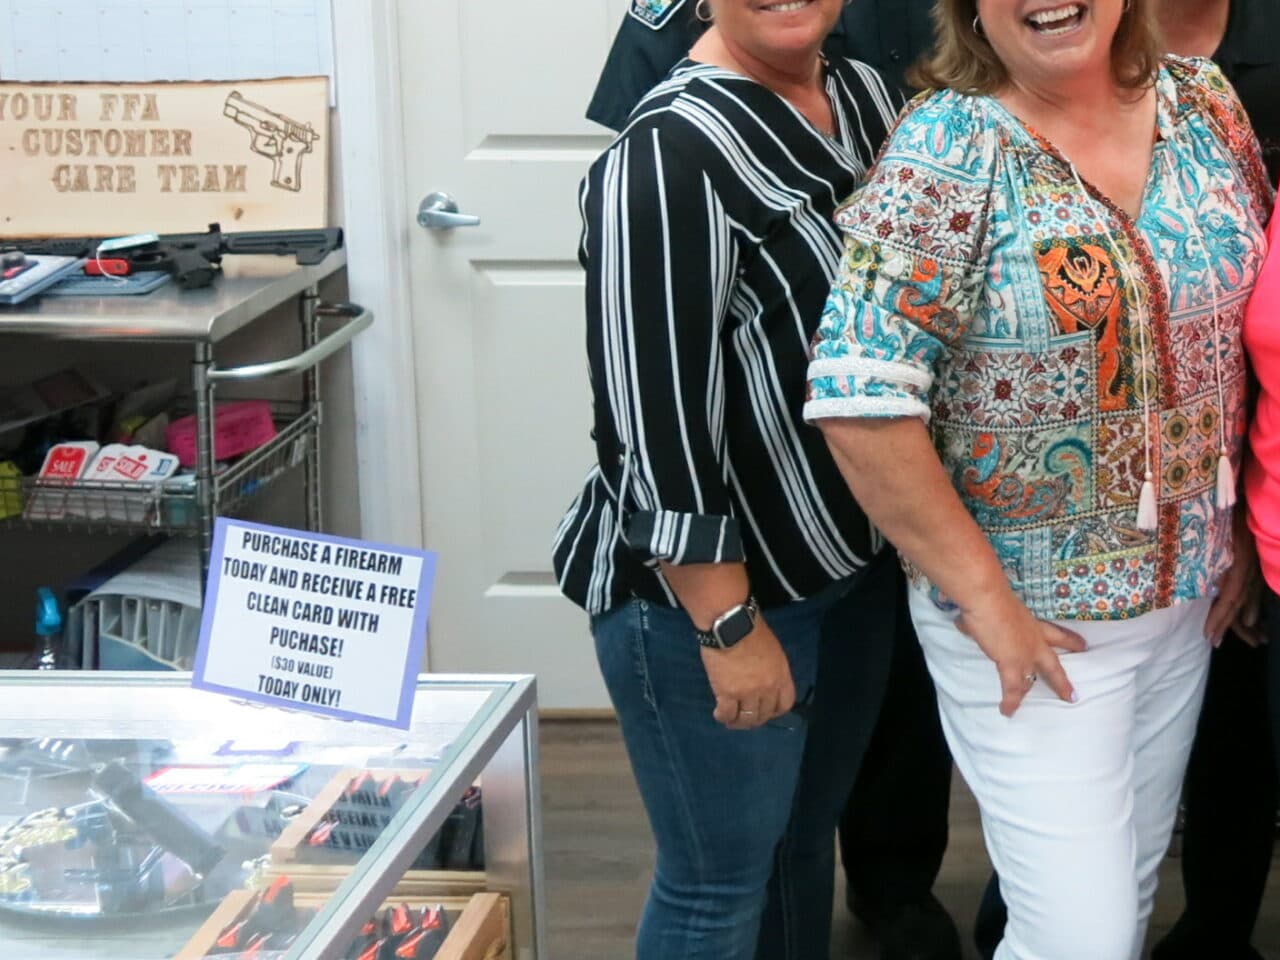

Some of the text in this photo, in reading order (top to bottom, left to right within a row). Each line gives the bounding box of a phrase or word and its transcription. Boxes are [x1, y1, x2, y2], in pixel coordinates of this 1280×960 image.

[99, 93, 160, 122] FFA
[22, 129, 193, 157] CUSTOMER
[53, 164, 248, 193] CARE TEAM
[53, 460, 75, 474] SALE
[242, 531, 403, 575] PURCHASE A FIREARM
[224, 557, 416, 609] TODAY AND RECEIVE A FREE
[247, 592, 380, 633] CLEAN CARD WITH
[270, 626, 344, 658] PUCHASE!
[258, 674, 342, 707] TODAY ONLY!
